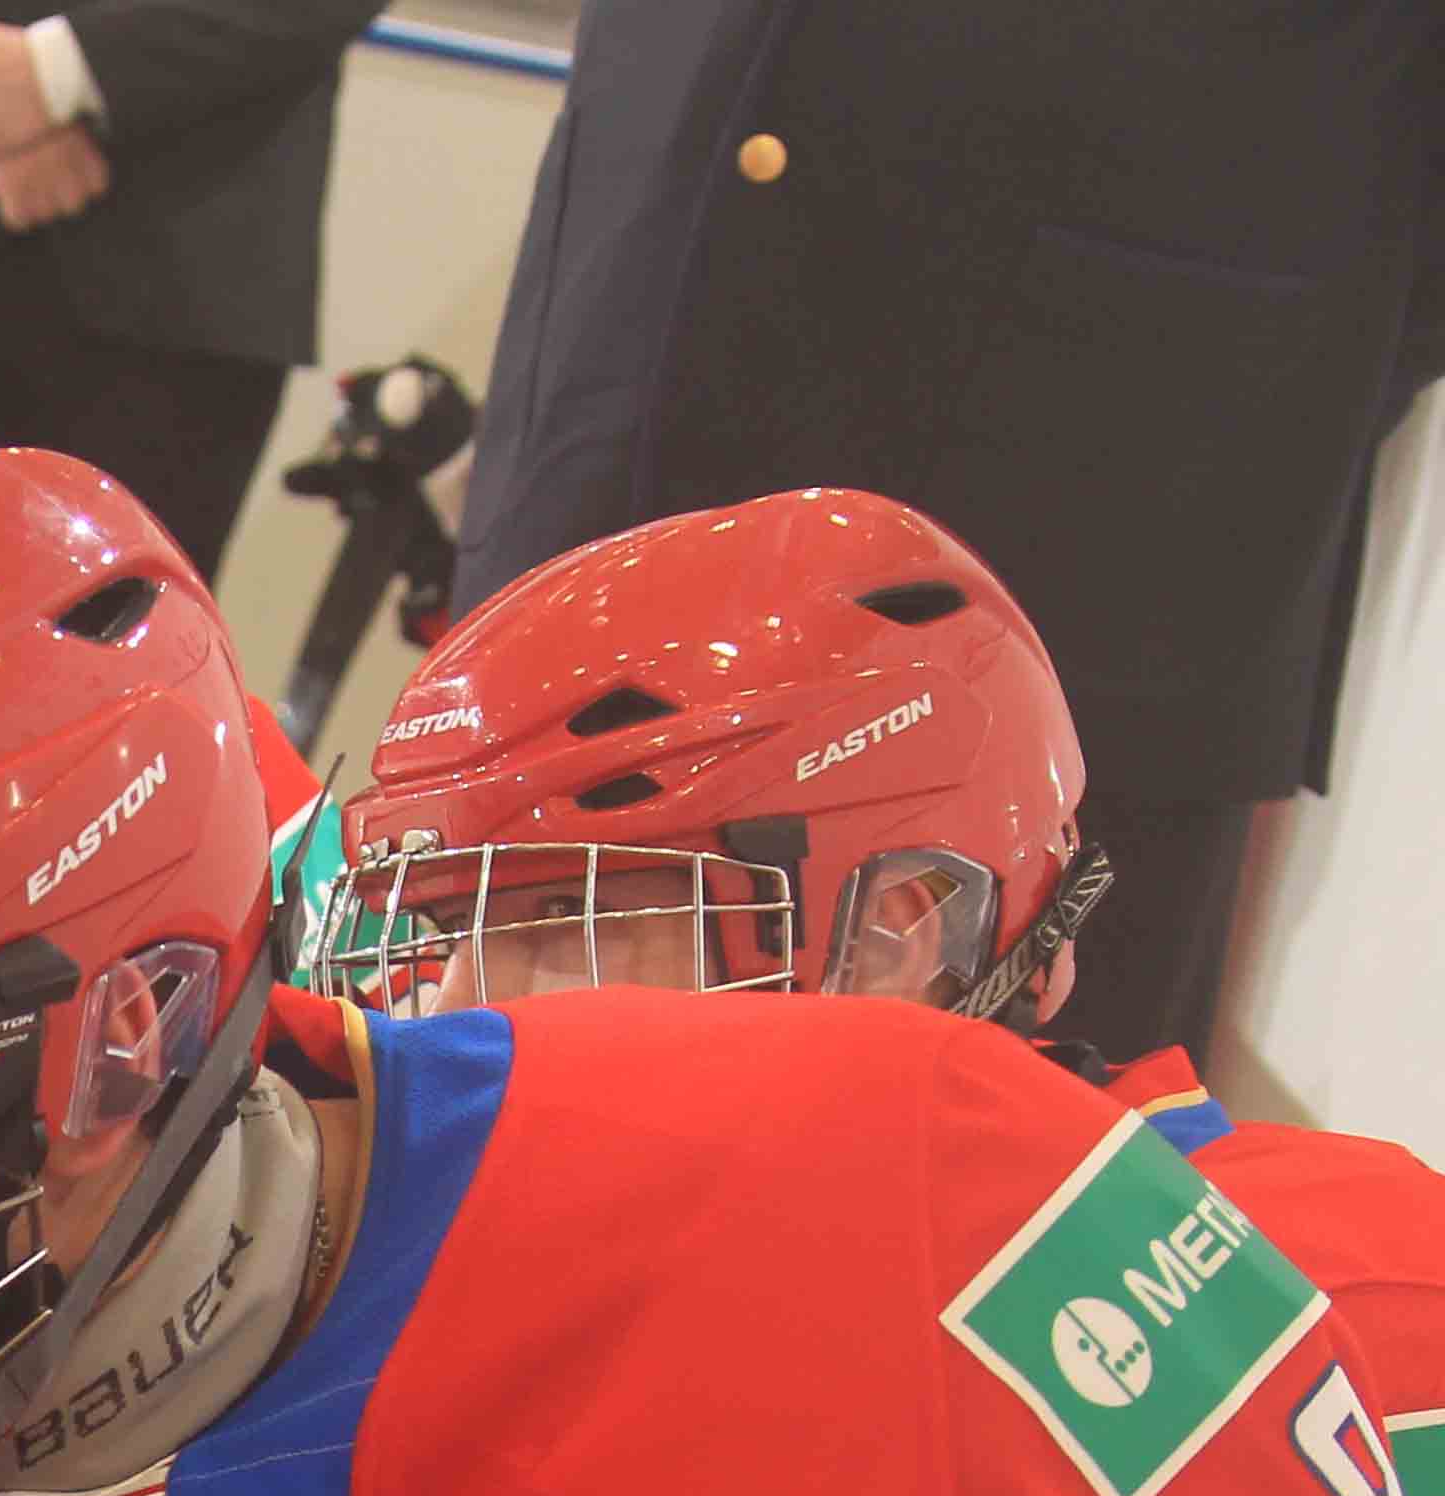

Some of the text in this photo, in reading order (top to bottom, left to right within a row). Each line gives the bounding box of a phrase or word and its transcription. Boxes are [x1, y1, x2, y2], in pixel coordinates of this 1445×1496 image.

[379, 704, 481, 744] EASTON
[796, 694, 933, 782] EASTON
[25, 762, 168, 905] EASTON
